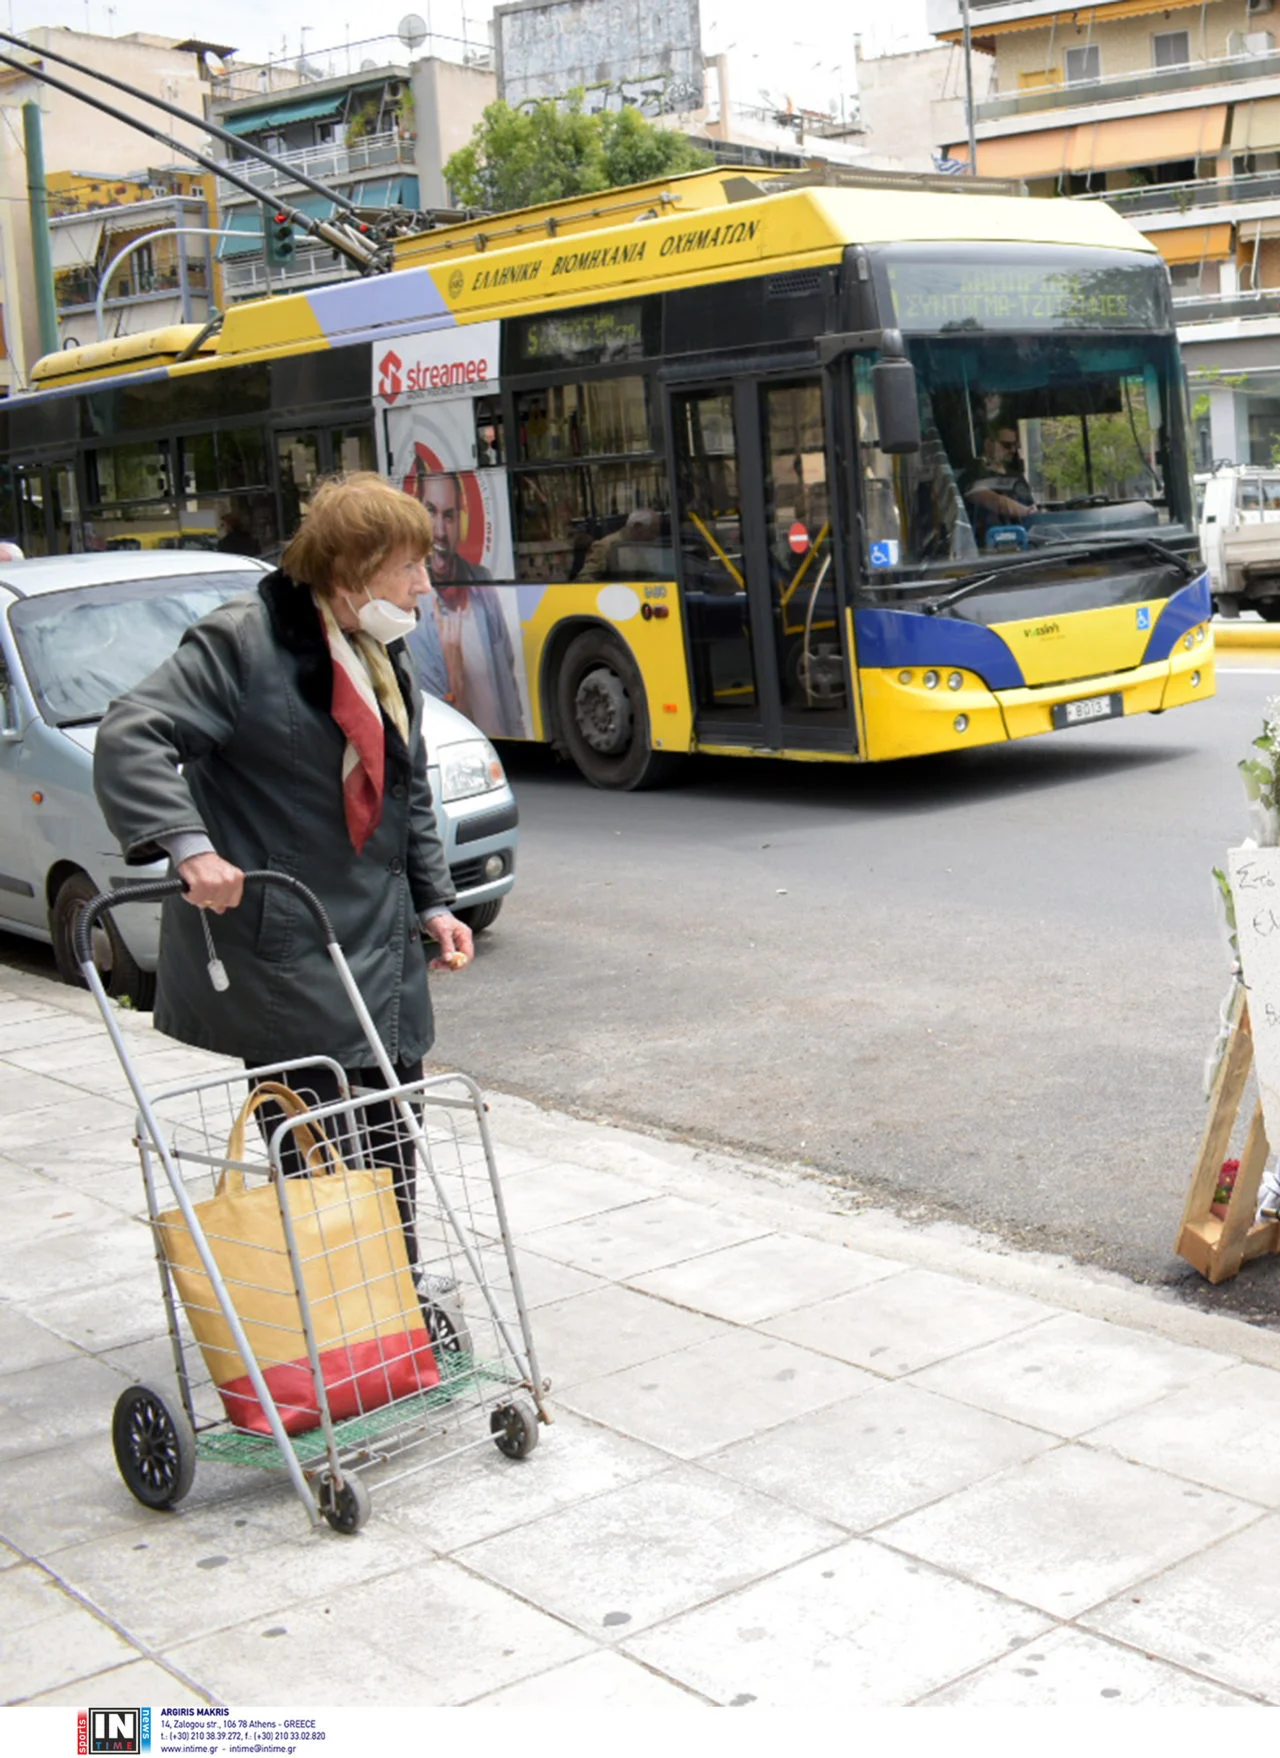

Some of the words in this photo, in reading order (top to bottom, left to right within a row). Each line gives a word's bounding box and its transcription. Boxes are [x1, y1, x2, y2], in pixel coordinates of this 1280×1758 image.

[471, 260, 542, 291] ΕΛΛΗΝΙΚΗ
[551, 241, 647, 276] ΒΙΟΜΗΧΑΝΙΑ
[659, 219, 761, 257] ΟΧΗΜΑΤΩΝ
[406, 358, 488, 390] streamee
[1075, 701, 1104, 717] 8013
